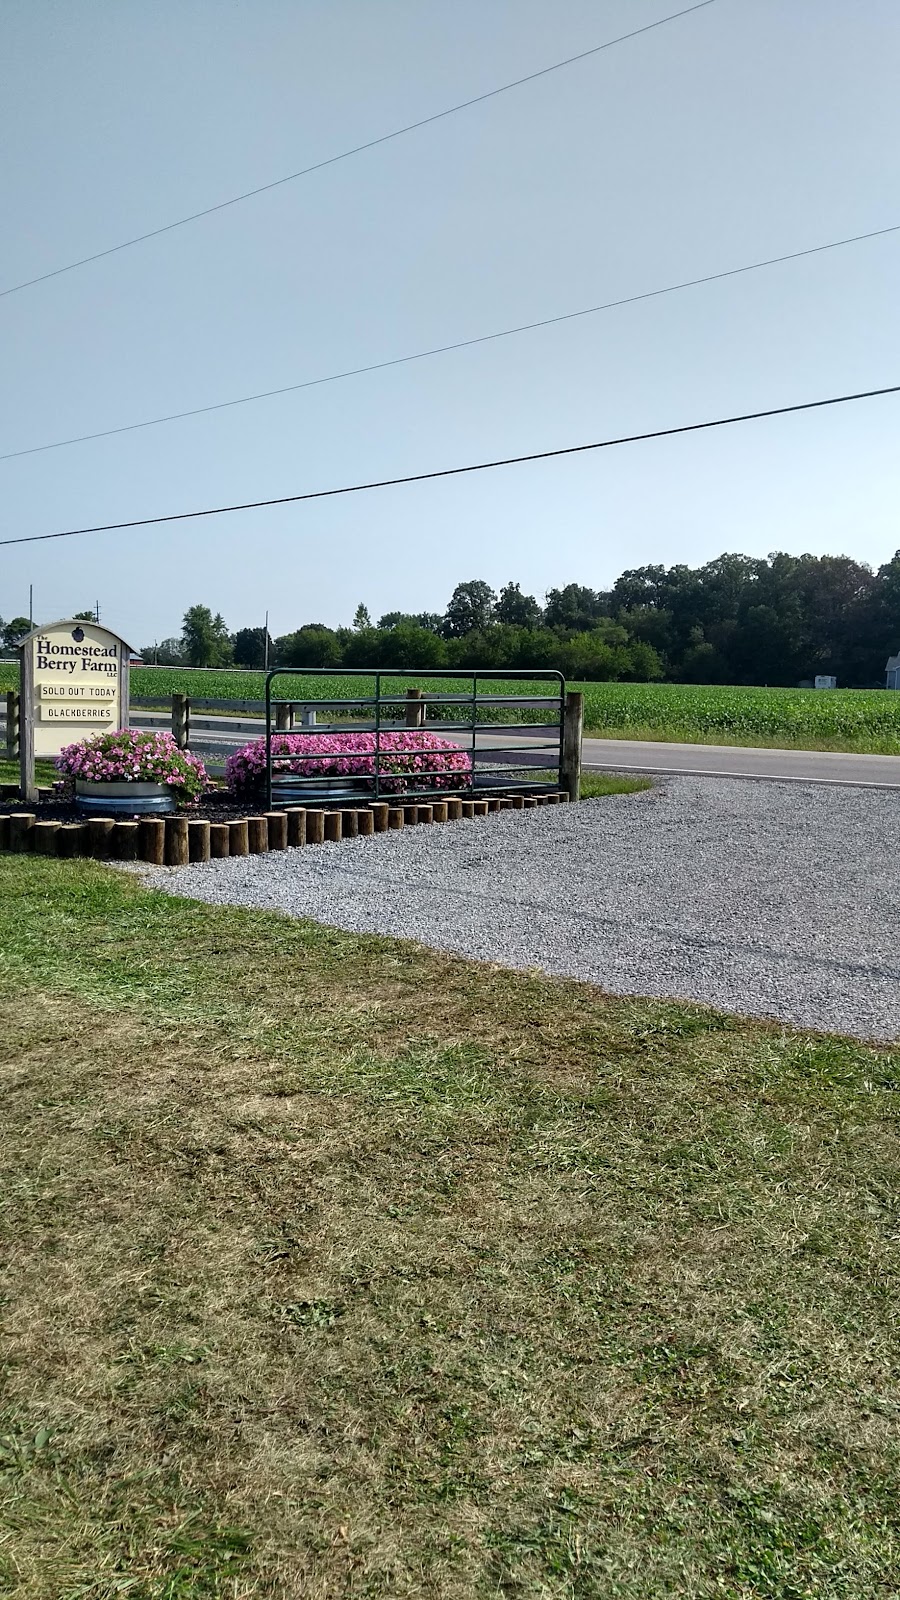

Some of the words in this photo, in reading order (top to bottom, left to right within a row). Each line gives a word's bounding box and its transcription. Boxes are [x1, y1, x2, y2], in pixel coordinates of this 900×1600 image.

[37, 641, 117, 657] Homestead
[36, 656, 77, 674] Berry
[81, 658, 117, 672] Farm
[43, 687, 65, 696] SOLD
[68, 687, 85, 696] OUT
[89, 688, 116, 697] TODAY
[48, 709, 111, 717] BLACKBERRIES
